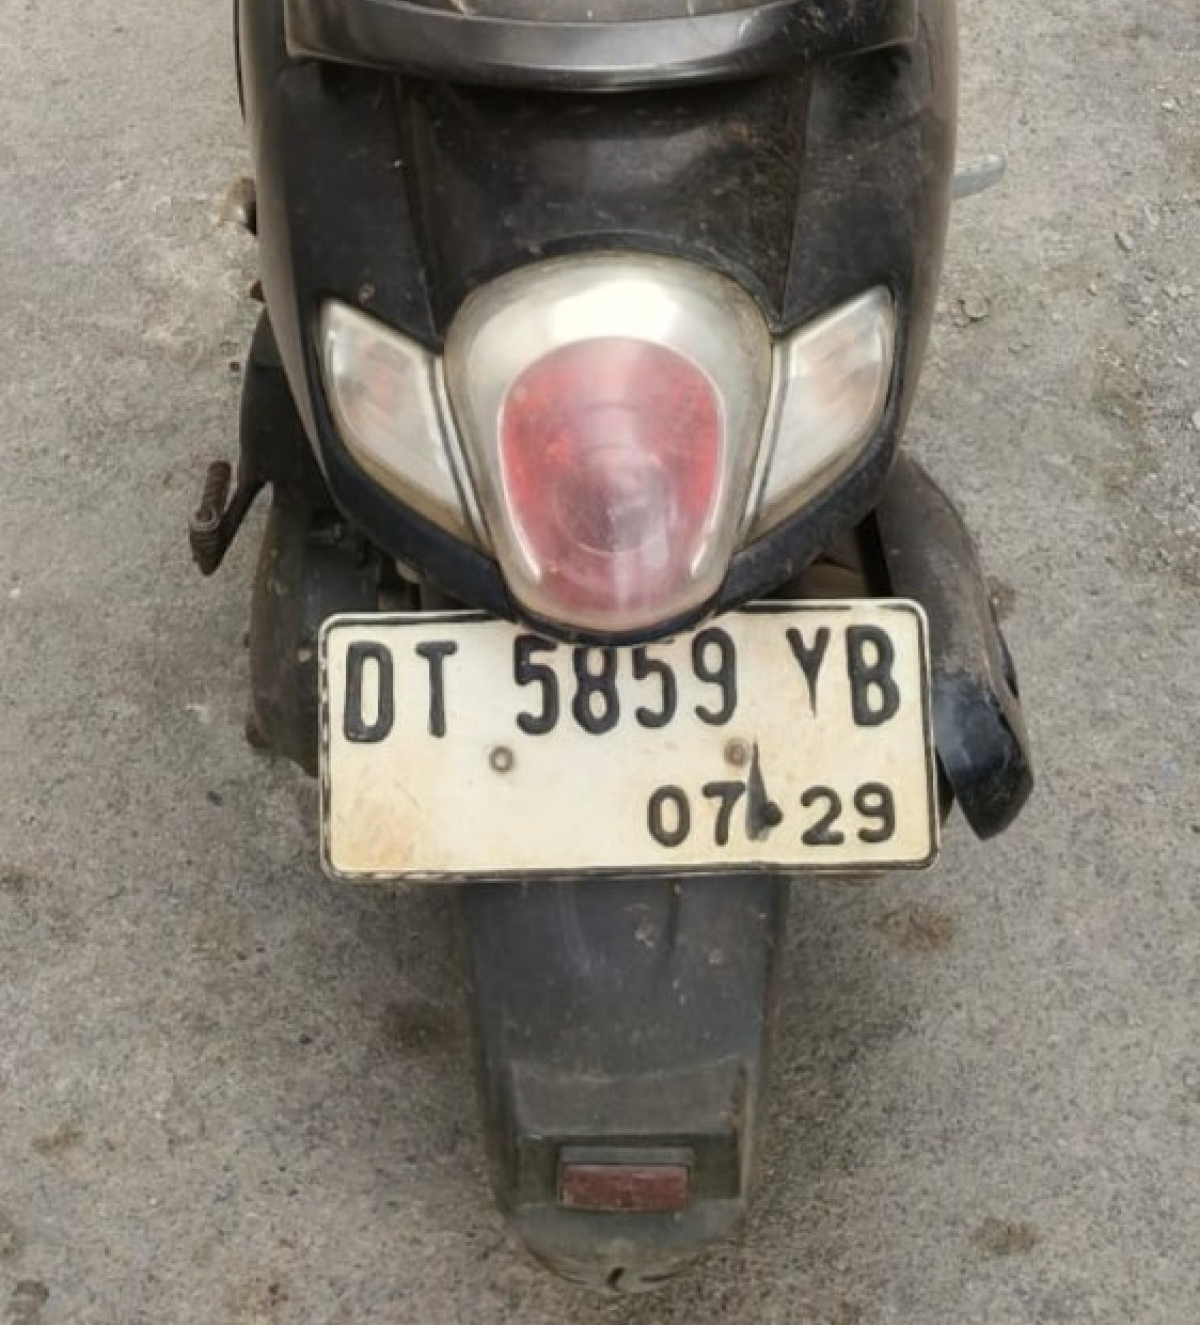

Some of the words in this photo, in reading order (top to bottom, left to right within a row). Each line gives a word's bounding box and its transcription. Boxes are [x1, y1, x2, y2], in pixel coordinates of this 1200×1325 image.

[343, 640, 456, 743] DT
[513, 627, 738, 735] 5859
[786, 624, 900, 727] YB
